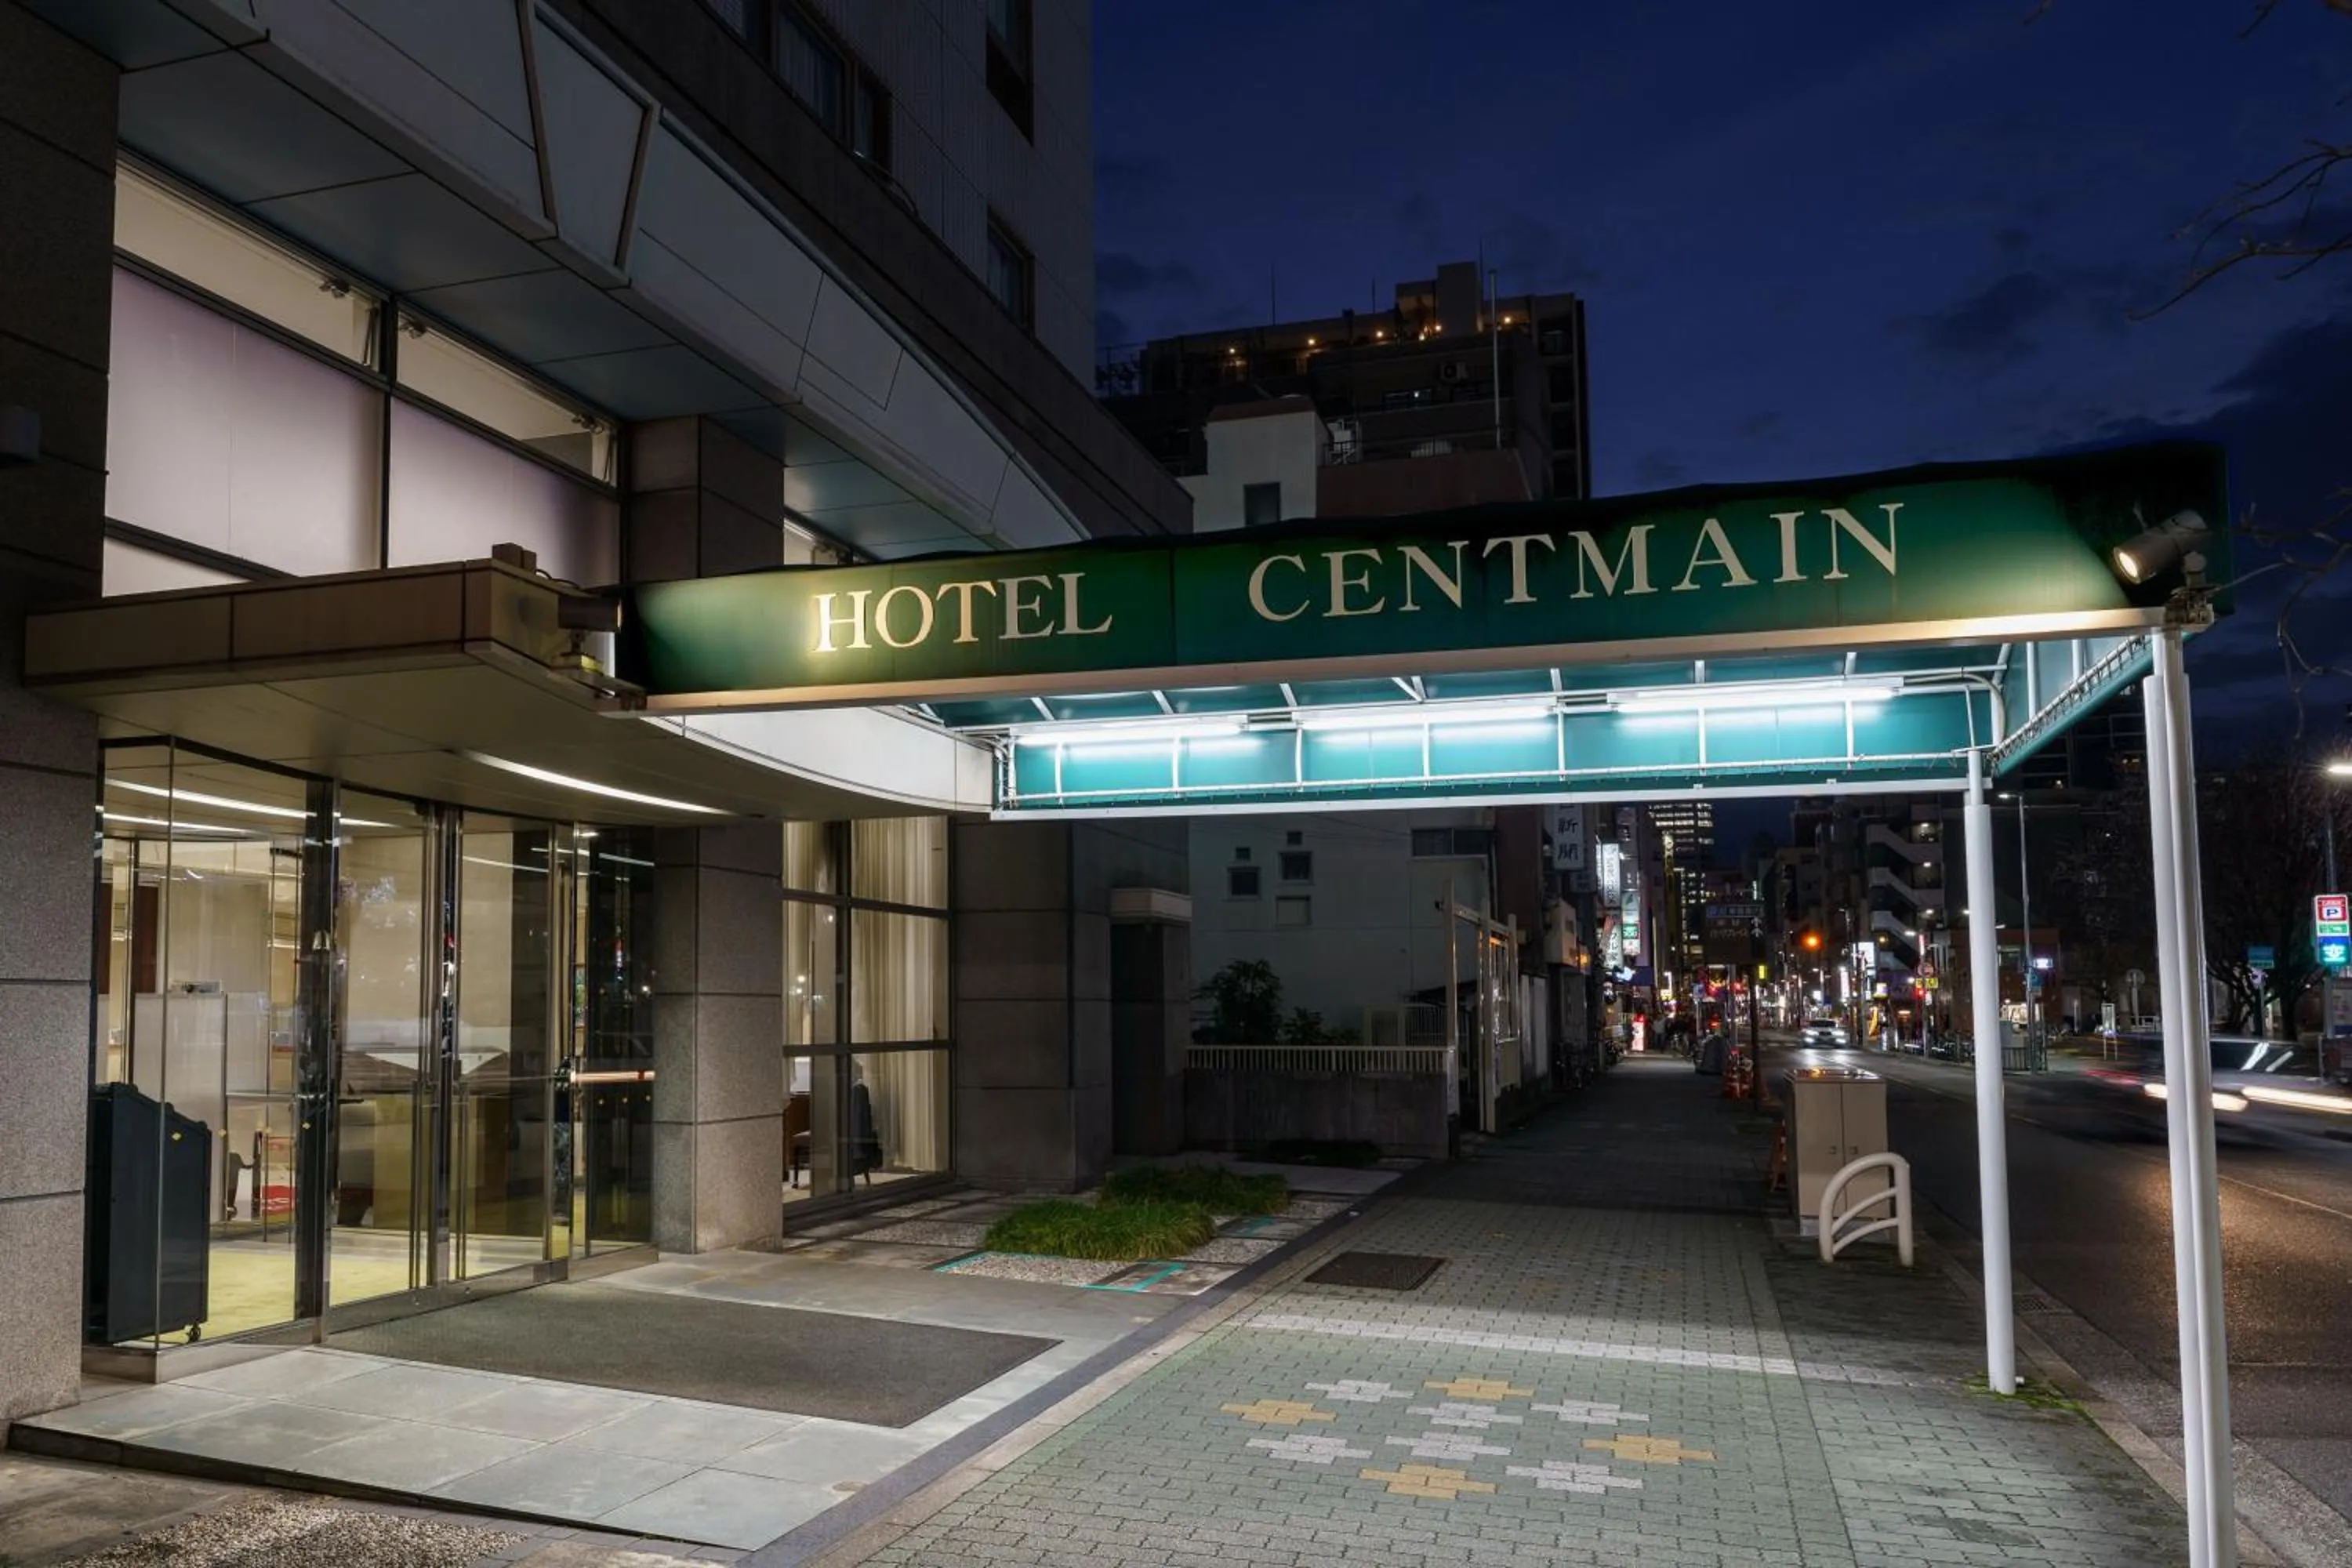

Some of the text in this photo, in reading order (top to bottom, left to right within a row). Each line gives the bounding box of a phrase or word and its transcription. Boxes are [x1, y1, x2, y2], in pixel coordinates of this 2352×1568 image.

[811, 503, 1904, 652] HOTEL CENTMAIN
[2326, 908, 2339, 917] P
